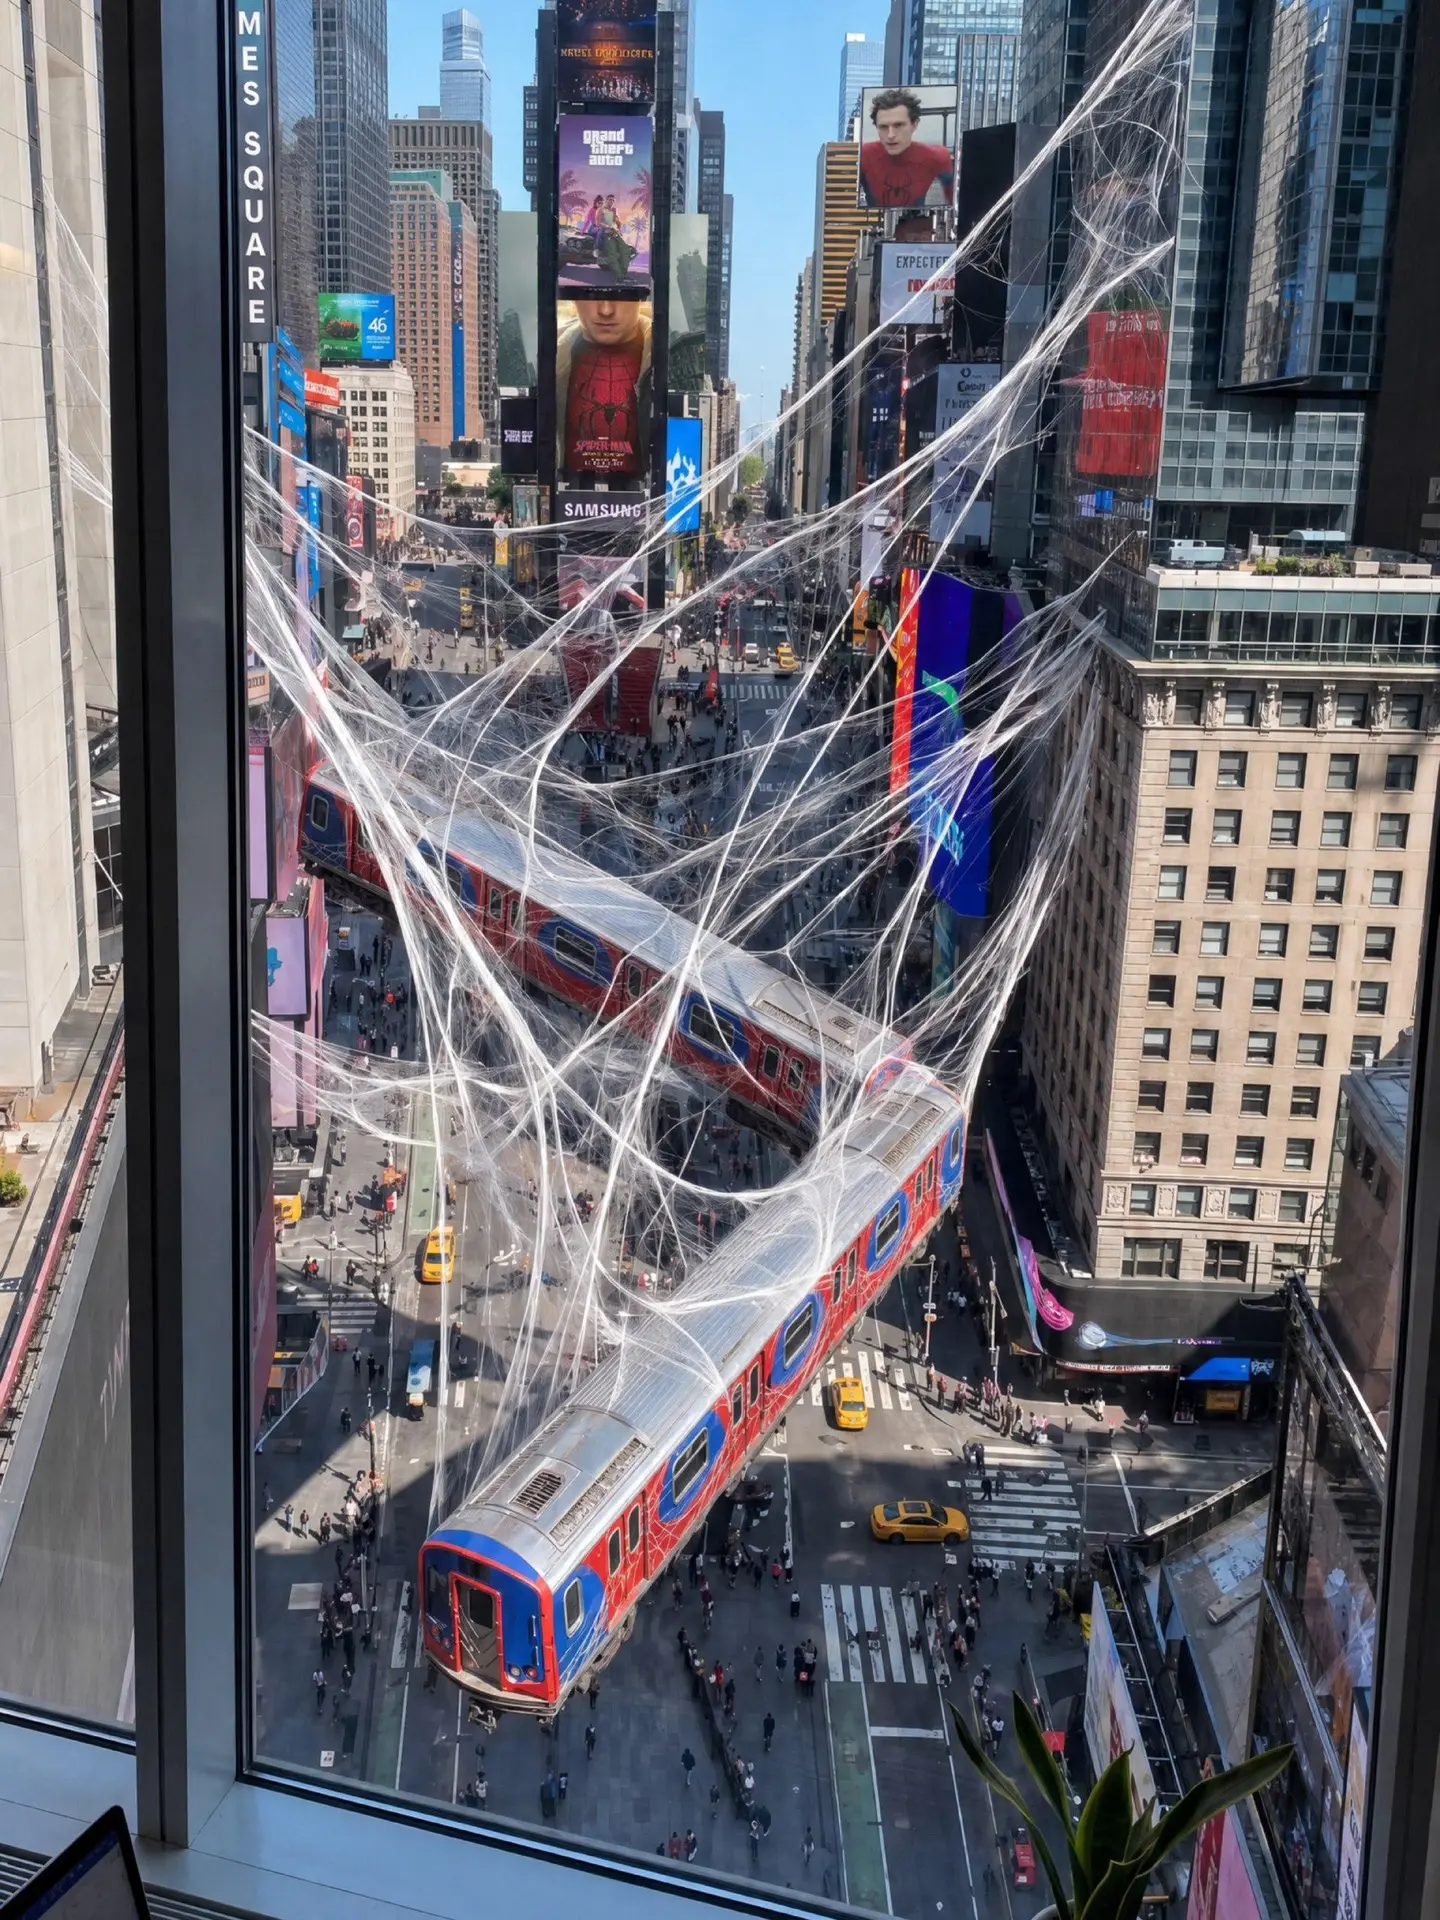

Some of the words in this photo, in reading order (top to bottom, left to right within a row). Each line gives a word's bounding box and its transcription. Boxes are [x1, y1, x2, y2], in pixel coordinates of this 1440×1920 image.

[583, 128, 625, 144] grand
[590, 143, 633, 155] theft
[589, 154, 623, 166] auto
[243, 131, 266, 324] SQUARE
[368, 317, 387, 333] 46
[564, 503, 641, 518] SAMSUNG
